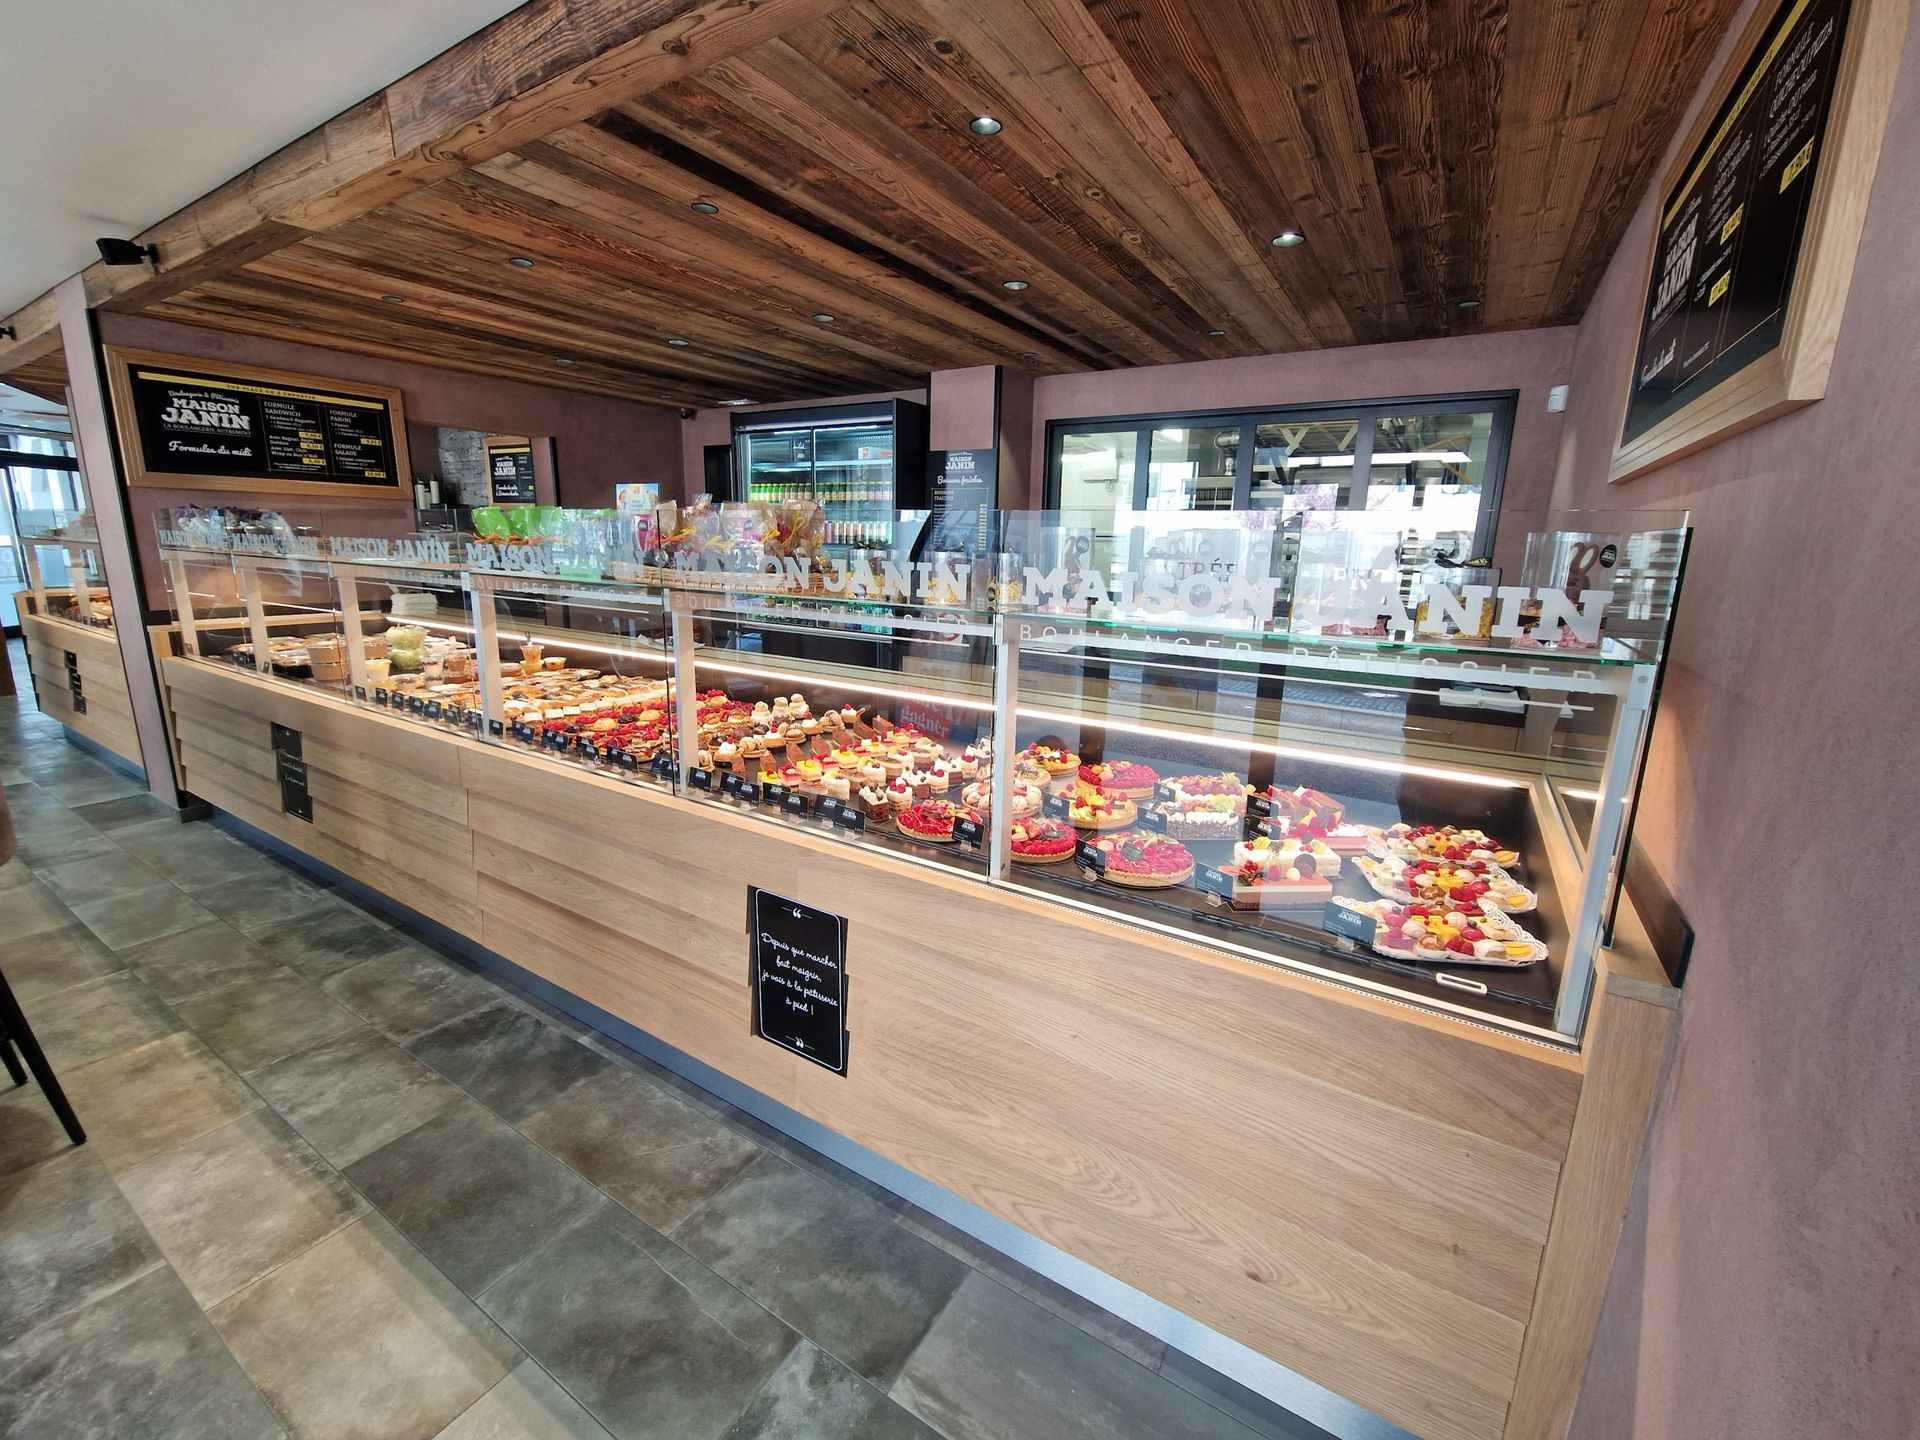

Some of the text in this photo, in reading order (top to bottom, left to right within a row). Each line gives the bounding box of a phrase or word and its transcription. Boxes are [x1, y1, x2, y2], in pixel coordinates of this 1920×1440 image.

[1767, 65, 1797, 123] QUICHE
[1808, 11, 1834, 65] PIZZA
[1774, 18, 1814, 92] FORMULE
[1662, 208, 1699, 279] MAISON
[1649, 232, 1698, 327] JANIN
[161, 407, 250, 430] JANIN
[172, 398, 240, 414] MAISON
[264, 402, 295, 410] FORMULE
[264, 408, 301, 417] SANDWICH
[173, 424, 215, 433] BOULANGERIE
[217, 428, 252, 436] AUTREMENT
[168, 440, 252, 456] Formules du midi
[494, 467, 516, 476] JANIN
[945, 462, 975, 470] JANIN
[330, 536, 449, 563] MAISON JANIN
[466, 542, 556, 575] MAISON
[823, 558, 970, 601] JANIN
[1023, 566, 1614, 643] MAISON ANIN
[900, 706, 948, 738] gagner
[761, 932, 838, 969] Depuis que marcher
[776, 955, 822, 982] fait maigrir,
[761, 969, 838, 1007] je vais à la pâtisserie
[785, 996, 814, 1015] à pied !
